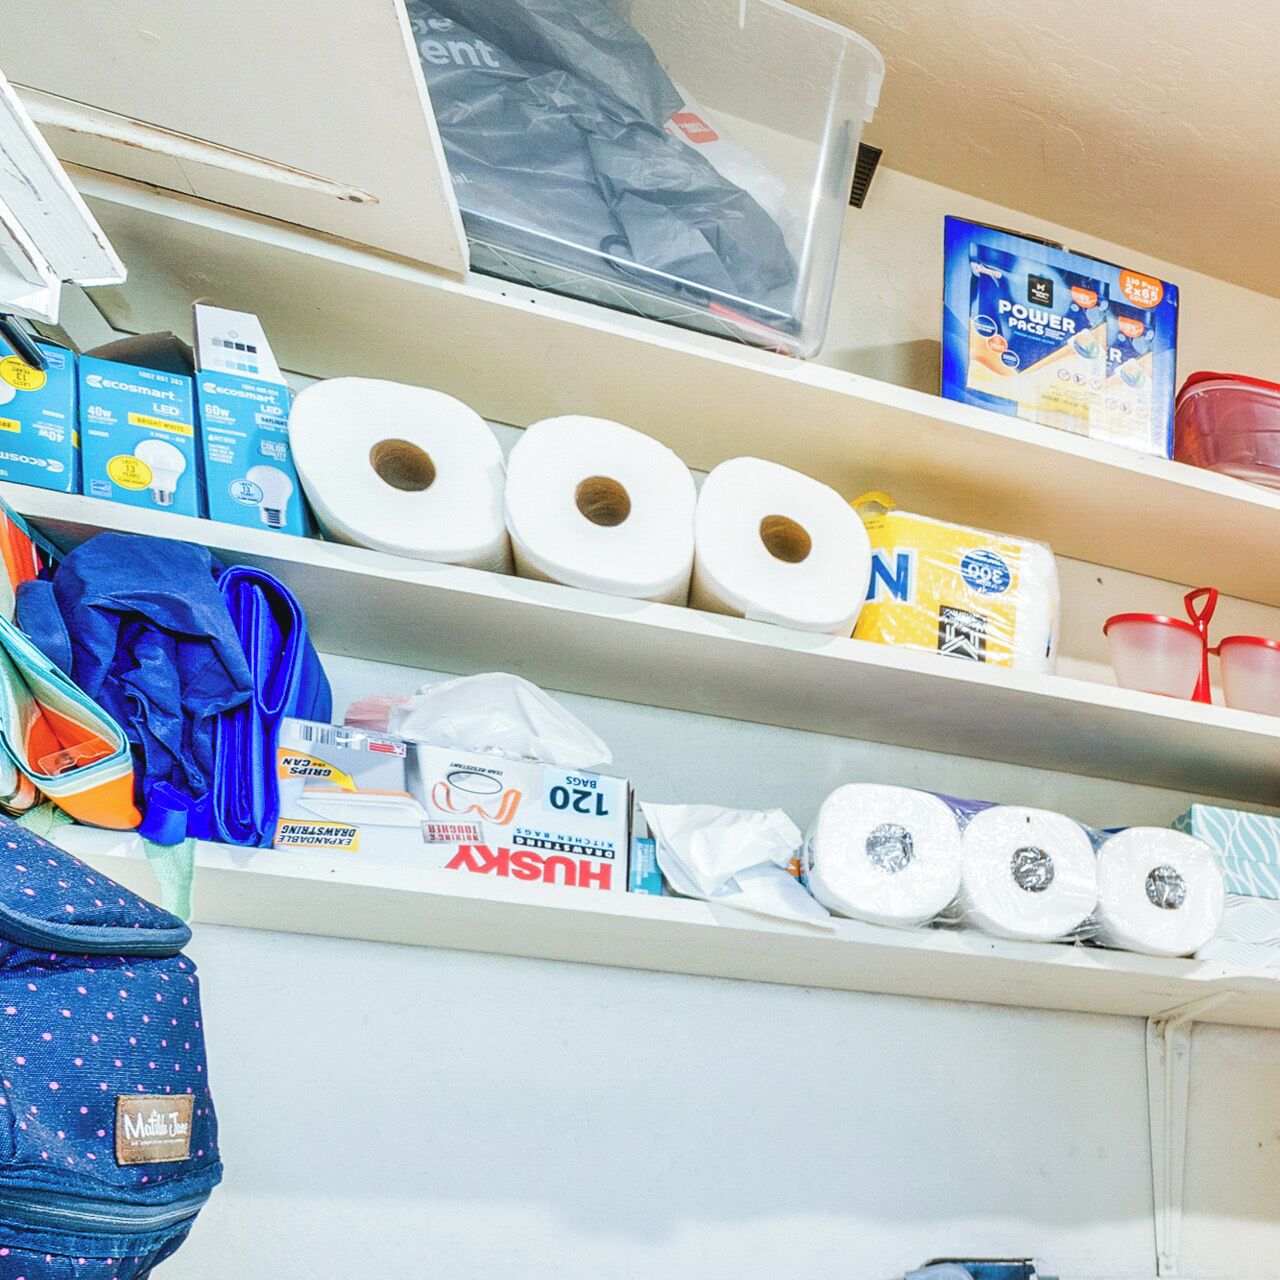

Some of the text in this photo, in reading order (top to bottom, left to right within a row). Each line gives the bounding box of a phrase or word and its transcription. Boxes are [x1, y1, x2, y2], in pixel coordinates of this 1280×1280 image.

[998, 298, 1076, 334] POWER
[1008, 317, 1044, 336] PACS
[102, 380, 175, 401] ecosmart
[215, 388, 276, 405] ecosmart
[152, 402, 181, 417] LED
[282, 757, 311, 767] CAN
[289, 767, 332, 777] GRIPS
[565, 775, 597, 789] BAGS
[549, 785, 609, 817] 120
[277, 834, 352, 846] EXPANDABLE
[280, 824, 357, 838] DRAWSTRING
[515, 827, 613, 848] KITCHEN BAGS
[514, 836, 612, 858] DRAWSTRING
[444, 844, 613, 891] HUSKY
